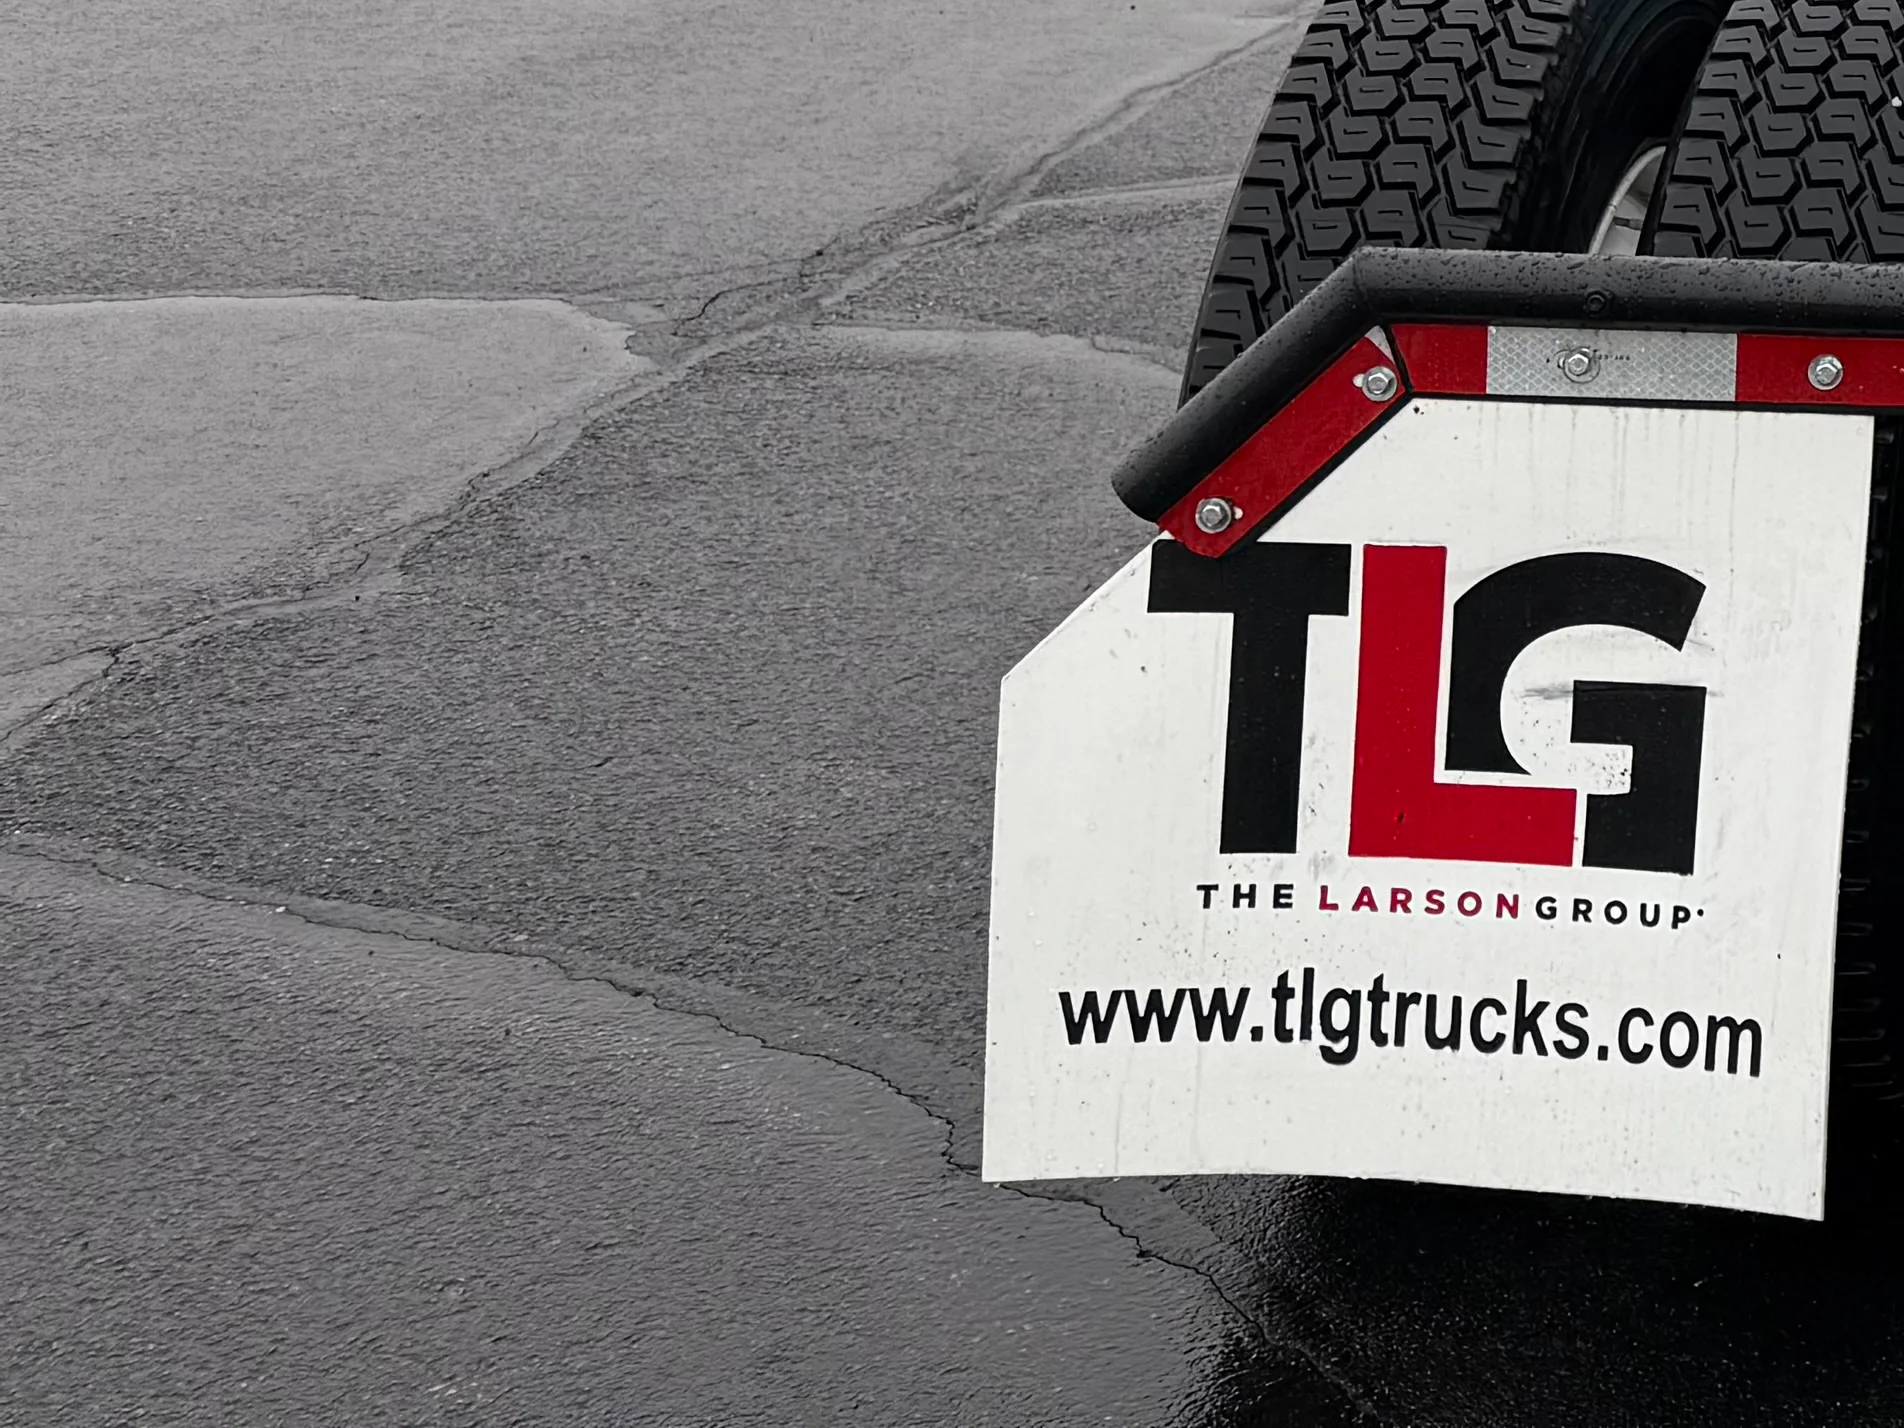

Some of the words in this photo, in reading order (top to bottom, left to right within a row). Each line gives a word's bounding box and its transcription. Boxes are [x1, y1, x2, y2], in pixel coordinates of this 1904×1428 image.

[1147, 539, 1708, 877] TLG
[1197, 883, 1294, 910] THE
[1058, 966, 1763, 1078] www.tlgtrucks.com
